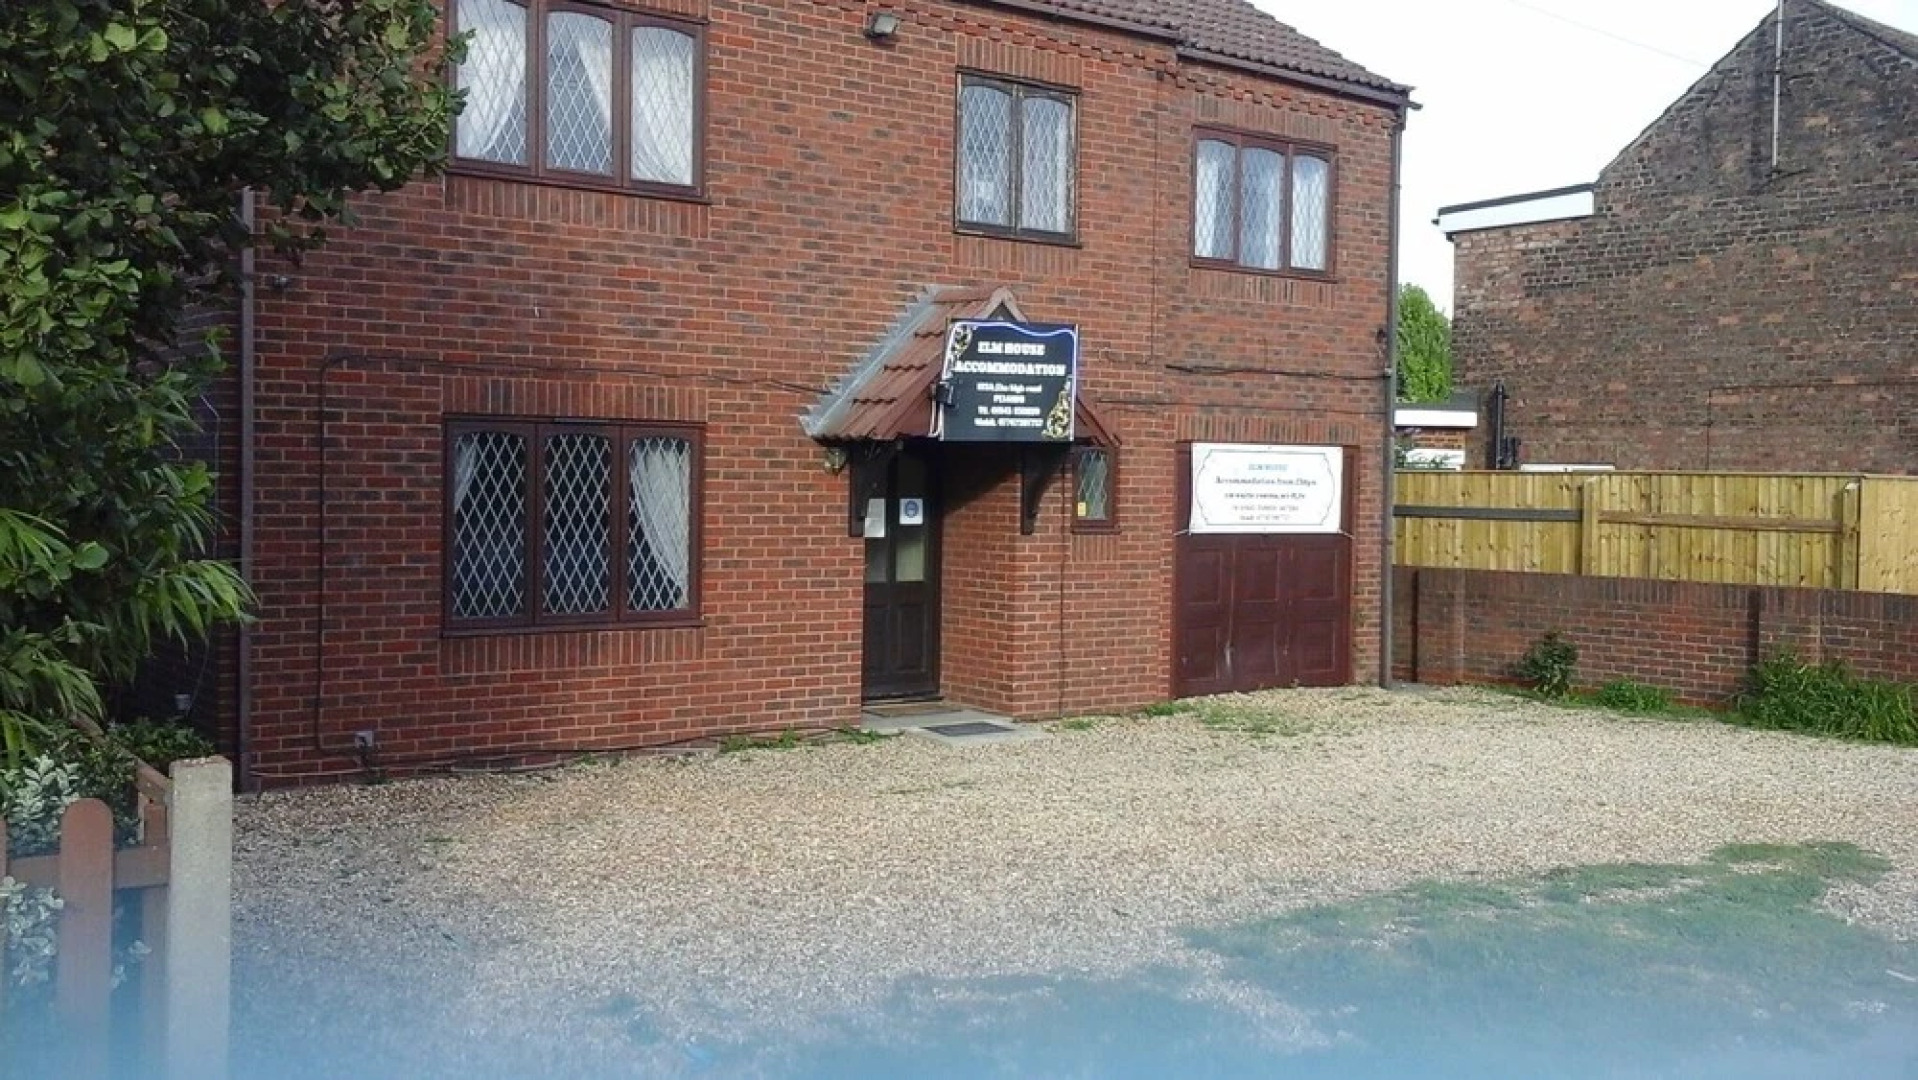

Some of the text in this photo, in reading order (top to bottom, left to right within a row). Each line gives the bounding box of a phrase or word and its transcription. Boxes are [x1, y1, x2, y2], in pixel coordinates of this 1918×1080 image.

[978, 341, 1046, 355] ELM HOUSE
[955, 360, 1067, 376] ACCOMMODATION
[1215, 475, 1275, 484] Accommodation
